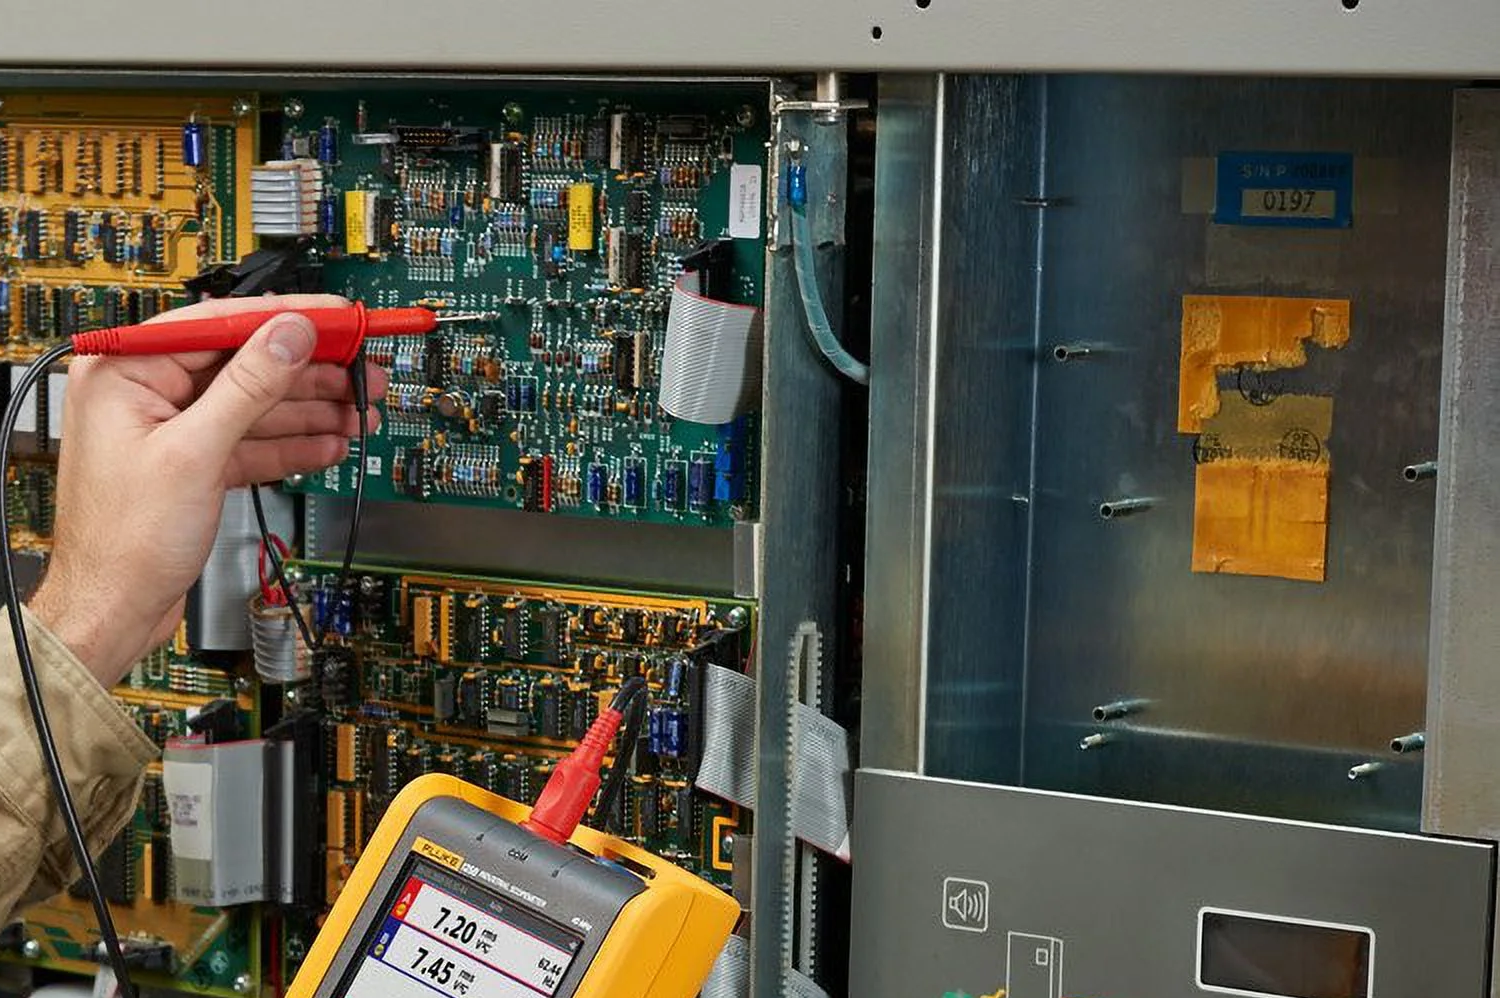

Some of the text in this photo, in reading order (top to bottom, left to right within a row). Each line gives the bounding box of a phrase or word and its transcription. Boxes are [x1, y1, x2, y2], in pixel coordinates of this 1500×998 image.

[1263, 190, 1315, 212] 0197
[422, 843, 459, 868] FLUKE
[402, 893, 412, 904] A
[433, 907, 477, 944] 7.20
[411, 947, 455, 985] 7.45
